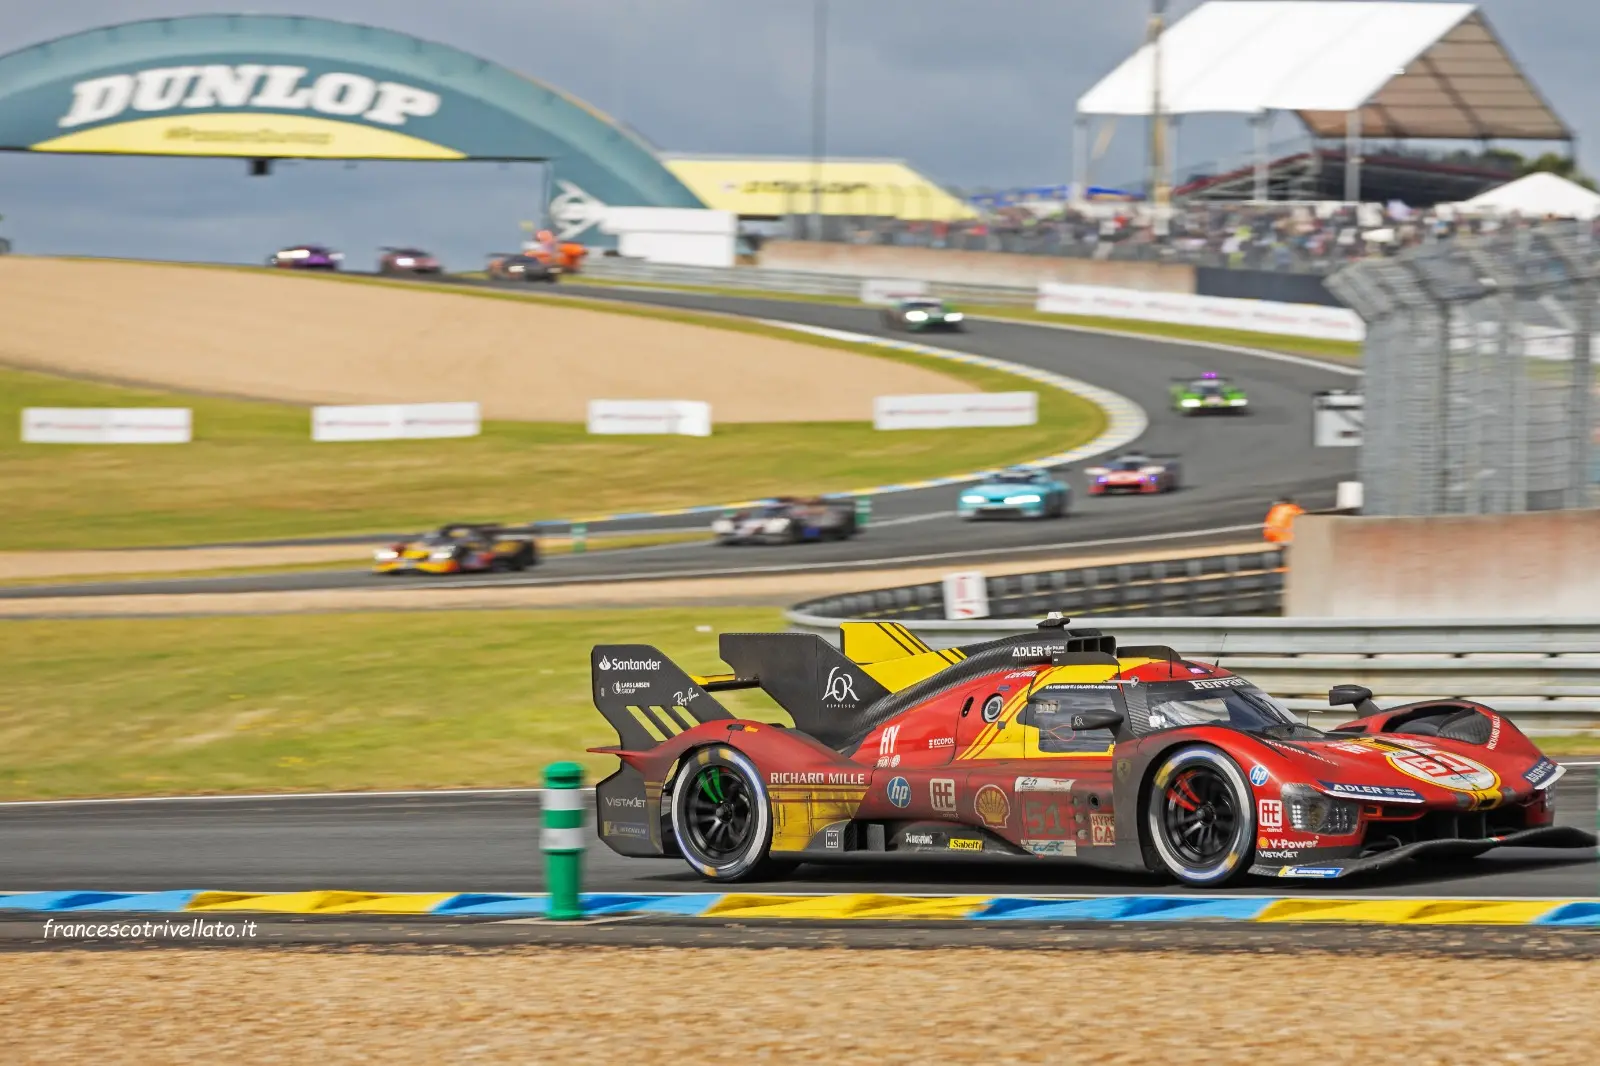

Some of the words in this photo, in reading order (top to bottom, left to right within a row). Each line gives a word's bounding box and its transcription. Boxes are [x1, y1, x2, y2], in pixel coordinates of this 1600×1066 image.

[58, 64, 441, 127] DUNLOP
[1012, 646, 1044, 657] ADLER
[612, 658, 661, 671] Santander
[1188, 676, 1250, 690] Ferrari
[673, 687, 700, 706] Ray-Ban
[879, 724, 900, 755] HY
[933, 737, 955, 746] ECOPOL
[1405, 753, 1472, 776] 51
[770, 772, 824, 784] RICHARD
[828, 773, 865, 785] MILLE
[1251, 765, 1267, 786] hp
[891, 777, 909, 808] hp
[1333, 783, 1383, 794] ADLER
[1025, 801, 1066, 835] 51
[1091, 815, 1115, 826] HYPE
[1094, 826, 1115, 843] CA
[1269, 838, 1319, 849] V-Power
